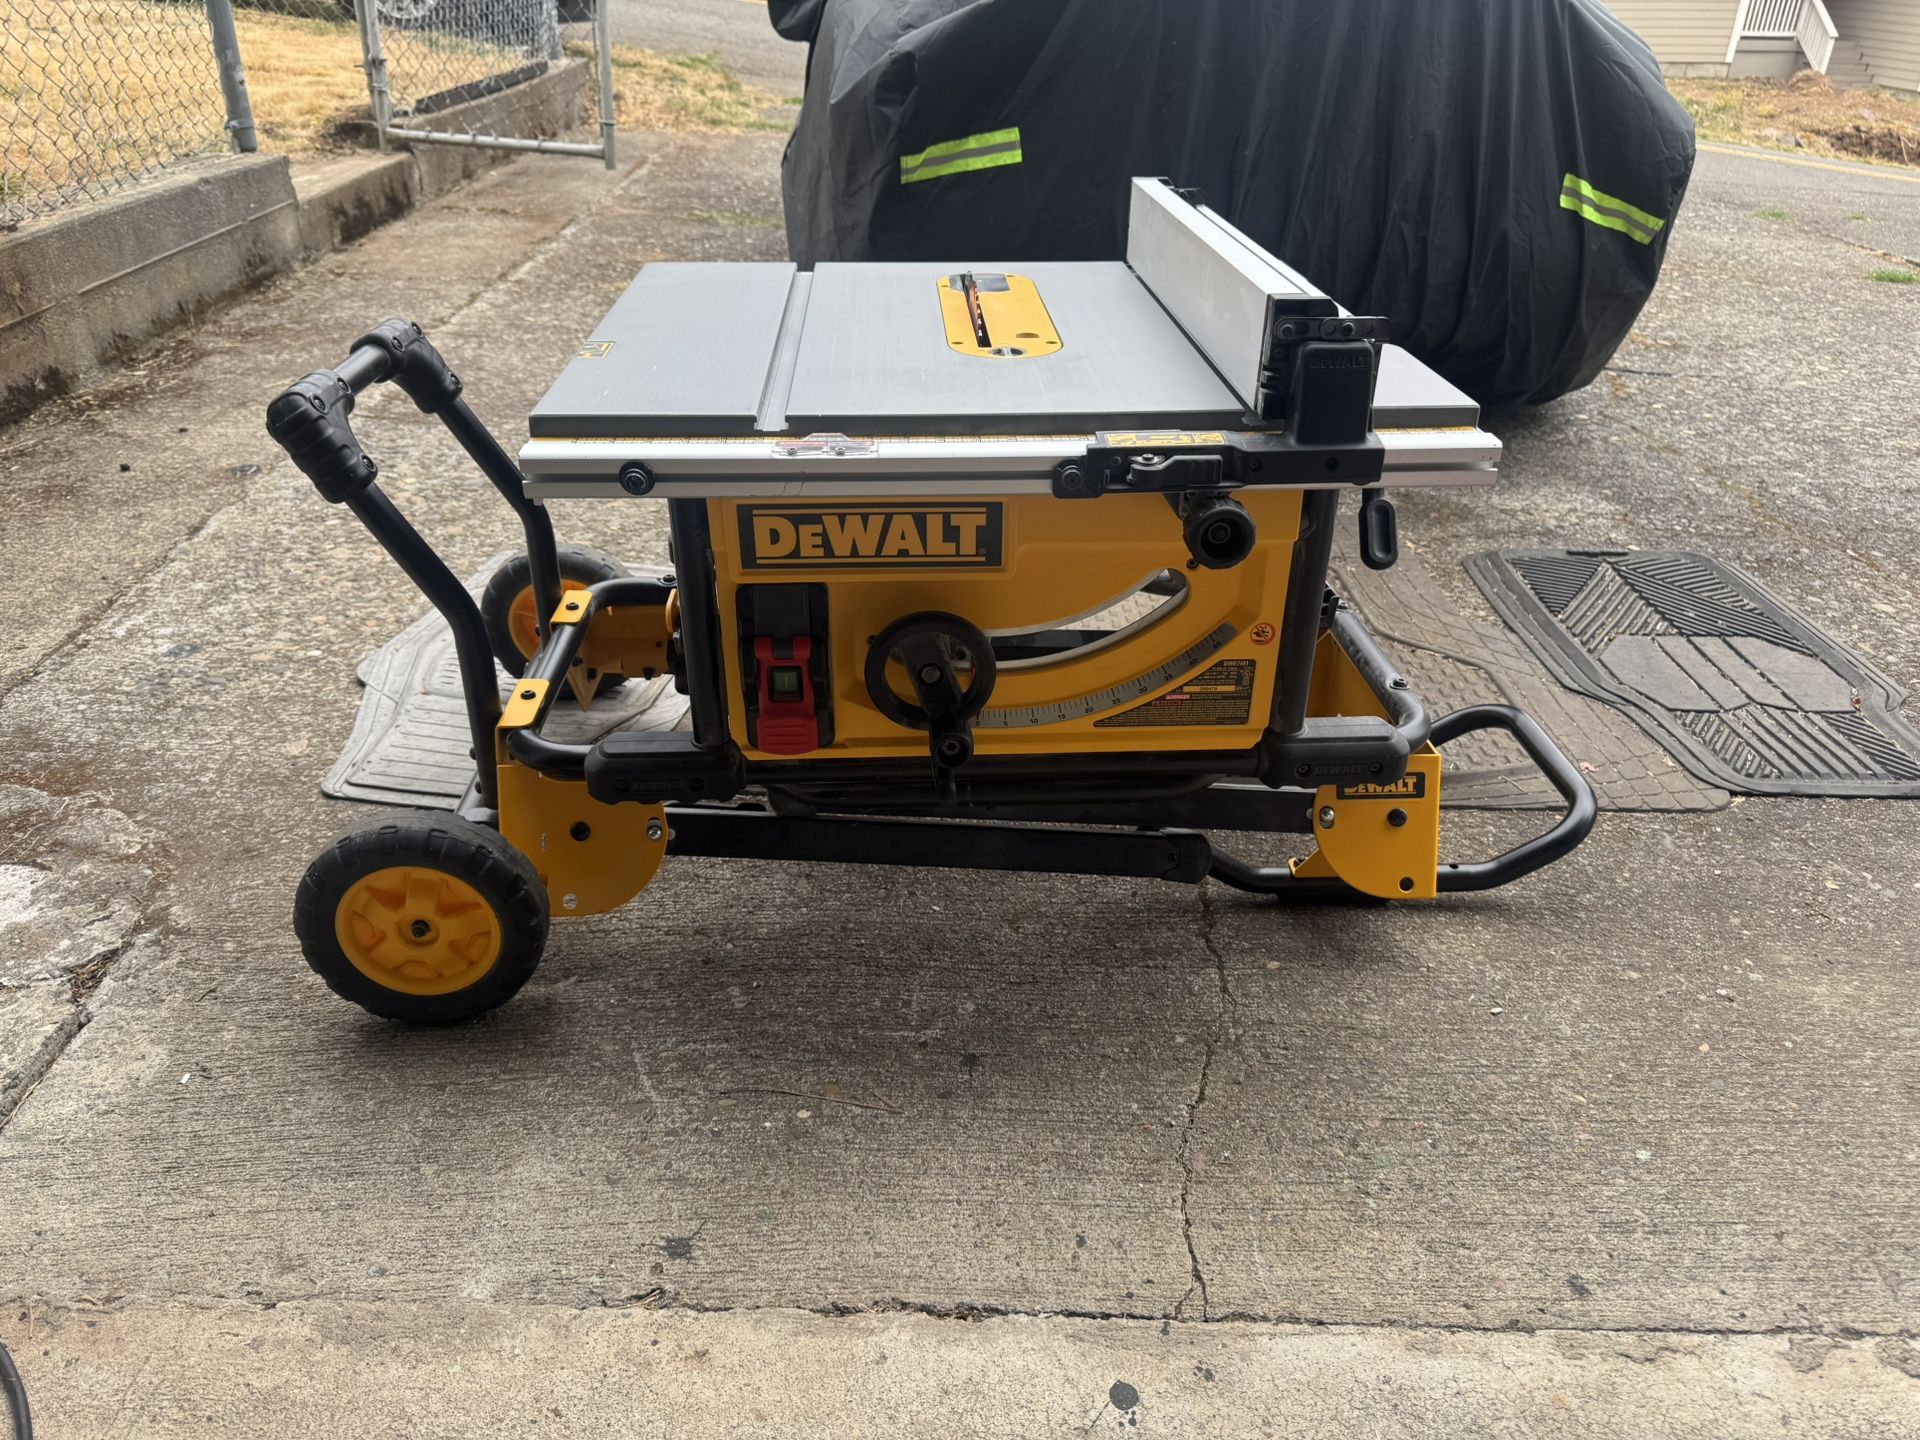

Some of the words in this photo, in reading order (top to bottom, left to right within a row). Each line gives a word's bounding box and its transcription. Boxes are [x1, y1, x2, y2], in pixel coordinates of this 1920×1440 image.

[752, 512, 987, 558] DEWALT
[1084, 706, 1094, 714] 20
[1112, 697, 1121, 705] 25
[1138, 686, 1148, 695] 30
[1188, 657, 1198, 667] 40
